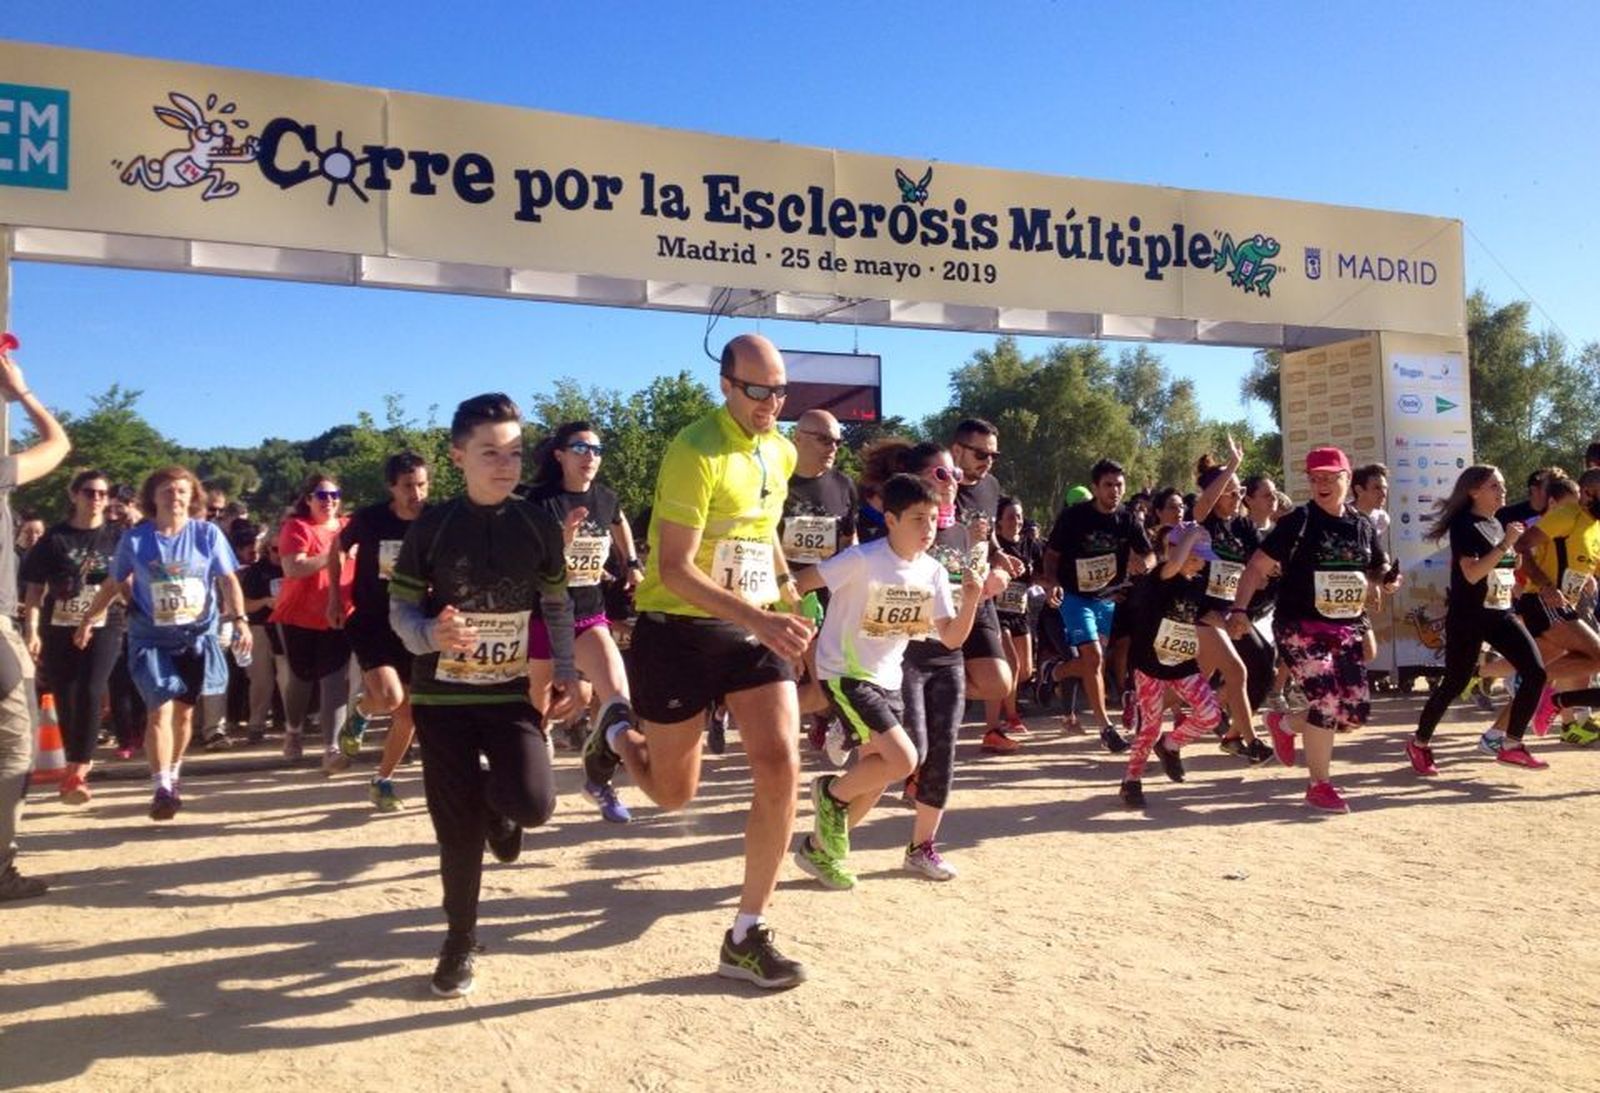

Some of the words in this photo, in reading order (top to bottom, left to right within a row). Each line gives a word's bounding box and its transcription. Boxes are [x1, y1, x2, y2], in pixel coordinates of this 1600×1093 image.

[257, 117, 495, 205] Corre
[514, 168, 623, 223] por
[640, 172, 691, 221] la
[702, 174, 999, 251] Esclerosis
[1009, 207, 1213, 281] Múltiple
[657, 234, 757, 266] Madrid
[780, 246, 811, 270] 25
[818, 249, 848, 273] de
[854, 258, 922, 283] mayo
[942, 260, 998, 284] 2019
[1338, 253, 1438, 286] MADRID
[794, 532, 825, 550] 362
[567, 555, 601, 571] 326
[1323, 587, 1363, 604] 1287
[873, 605, 922, 624] 1681
[1160, 636, 1197, 656] 1288
